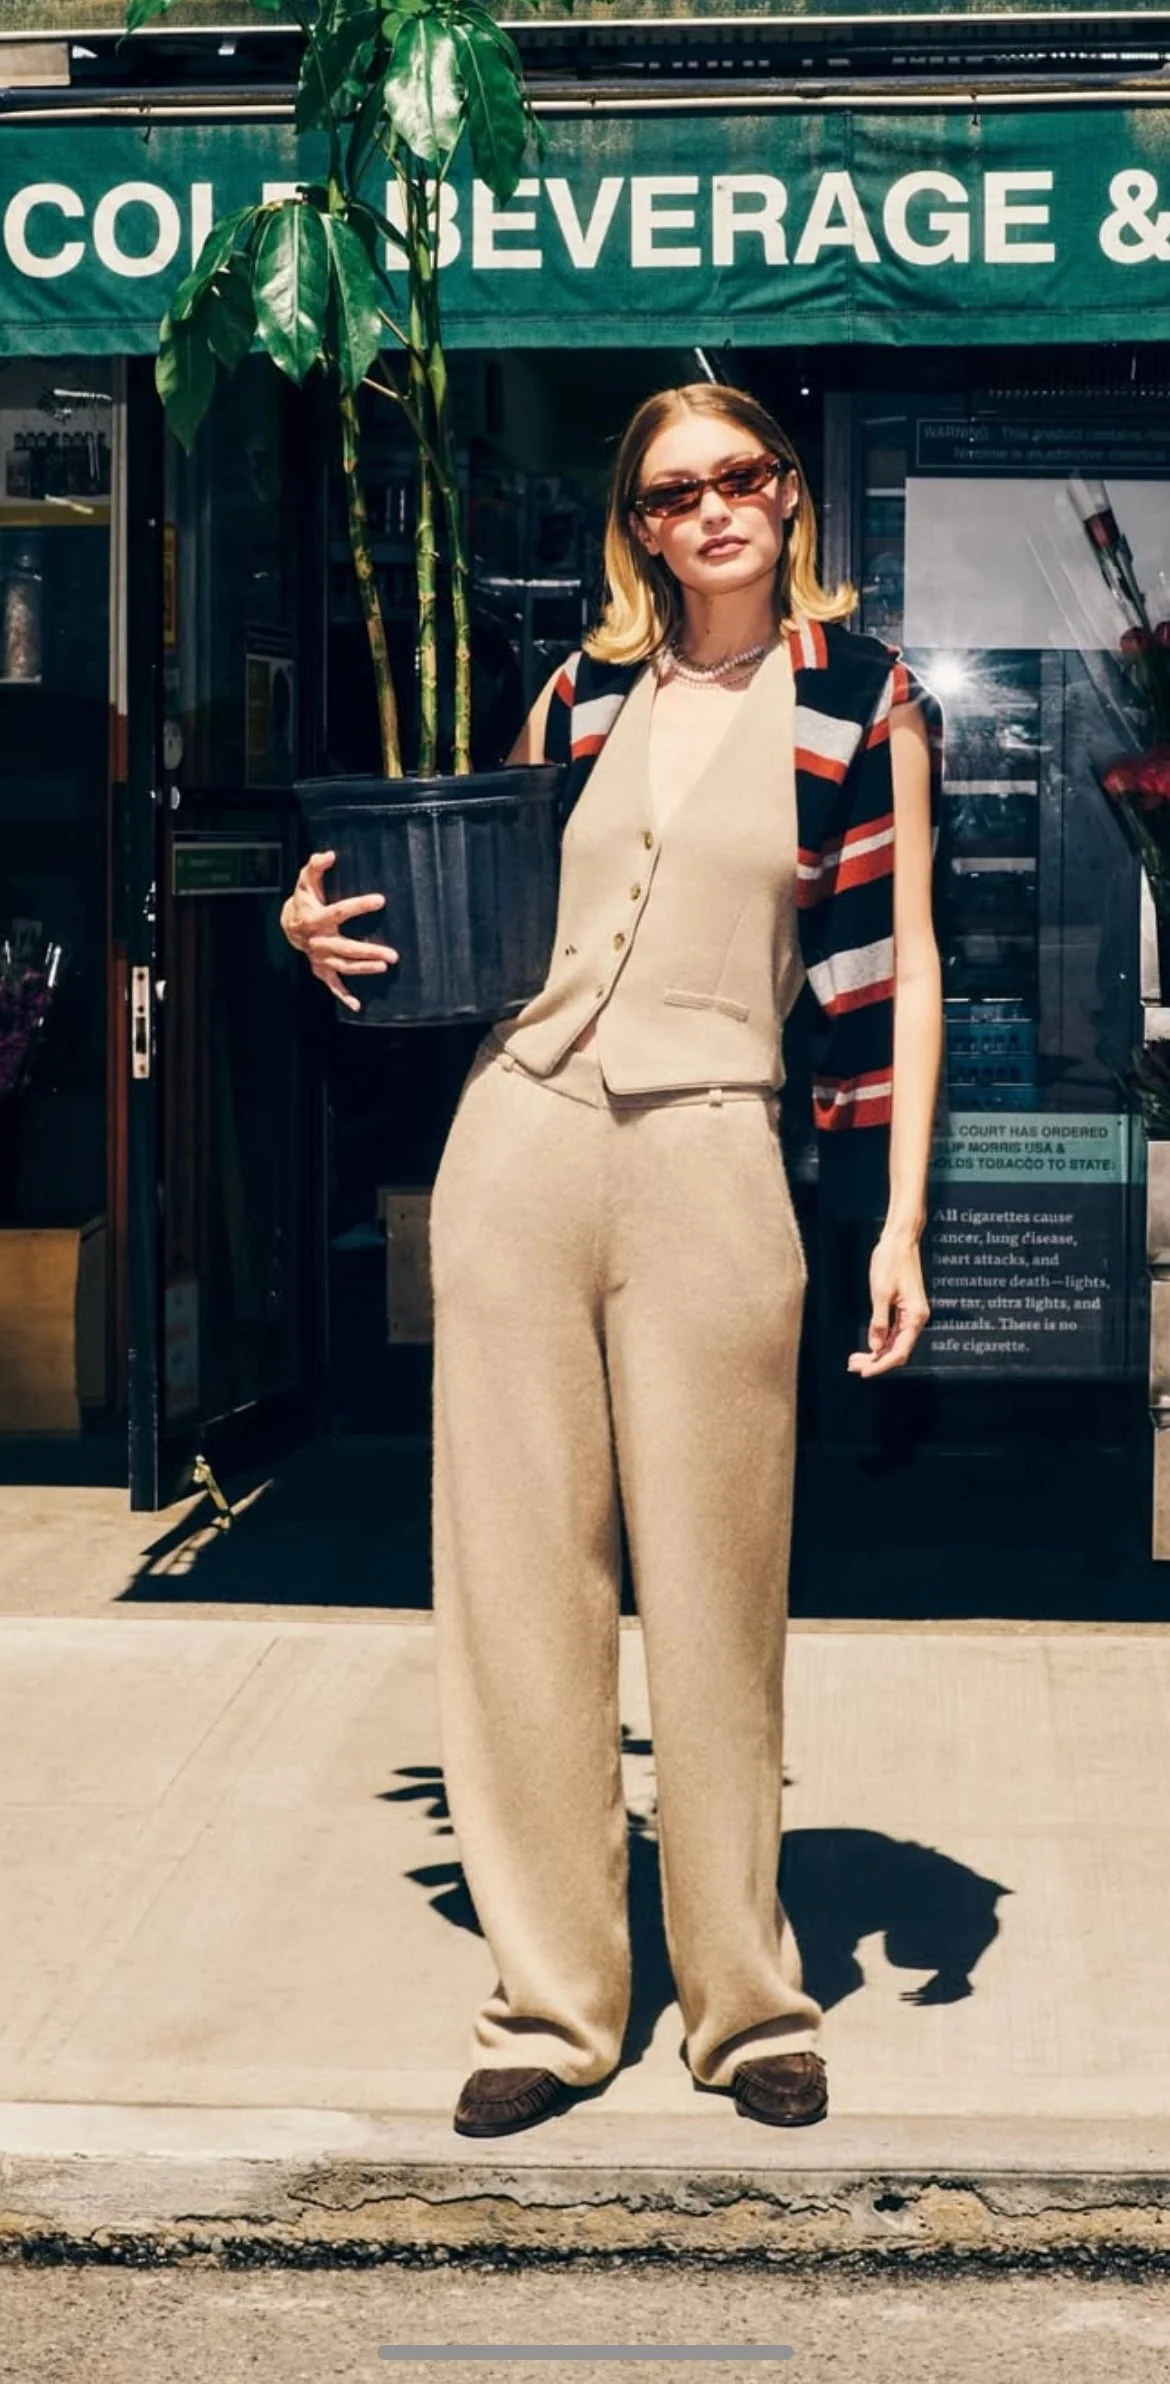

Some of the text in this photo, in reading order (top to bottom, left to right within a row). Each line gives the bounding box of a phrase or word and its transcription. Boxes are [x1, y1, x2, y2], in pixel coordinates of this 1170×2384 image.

[385, 170, 1055, 271] BEVERAGE
[1099, 169, 1170, 266] &
[1033, 426, 1083, 443] product
[959, 1125, 1006, 1138] COURT
[1010, 1125, 1037, 1138] HAS
[1041, 1125, 1108, 1138] ORDERED
[968, 1142, 1021, 1154] MORRIS
[1025, 1142, 1052, 1154] USA
[1056, 1142, 1066, 1154] &
[979, 1157, 1043, 1170] TOBACCO
[1048, 1157, 1065, 1170] TO
[933, 1208, 1074, 1226] All cigarettes cause
[986, 1232, 1019, 1247] lung
[1022, 1232, 1078, 1247] disease,
[933, 1251, 1060, 1268] heart attacks, and
[932, 1275, 1006, 1290] premature
[931, 1296, 1101, 1313] low tar, ultra lights, and
[932, 1317, 1077, 1331] naturals. There is no
[931, 1338, 1031, 1355] safe cigarette.
